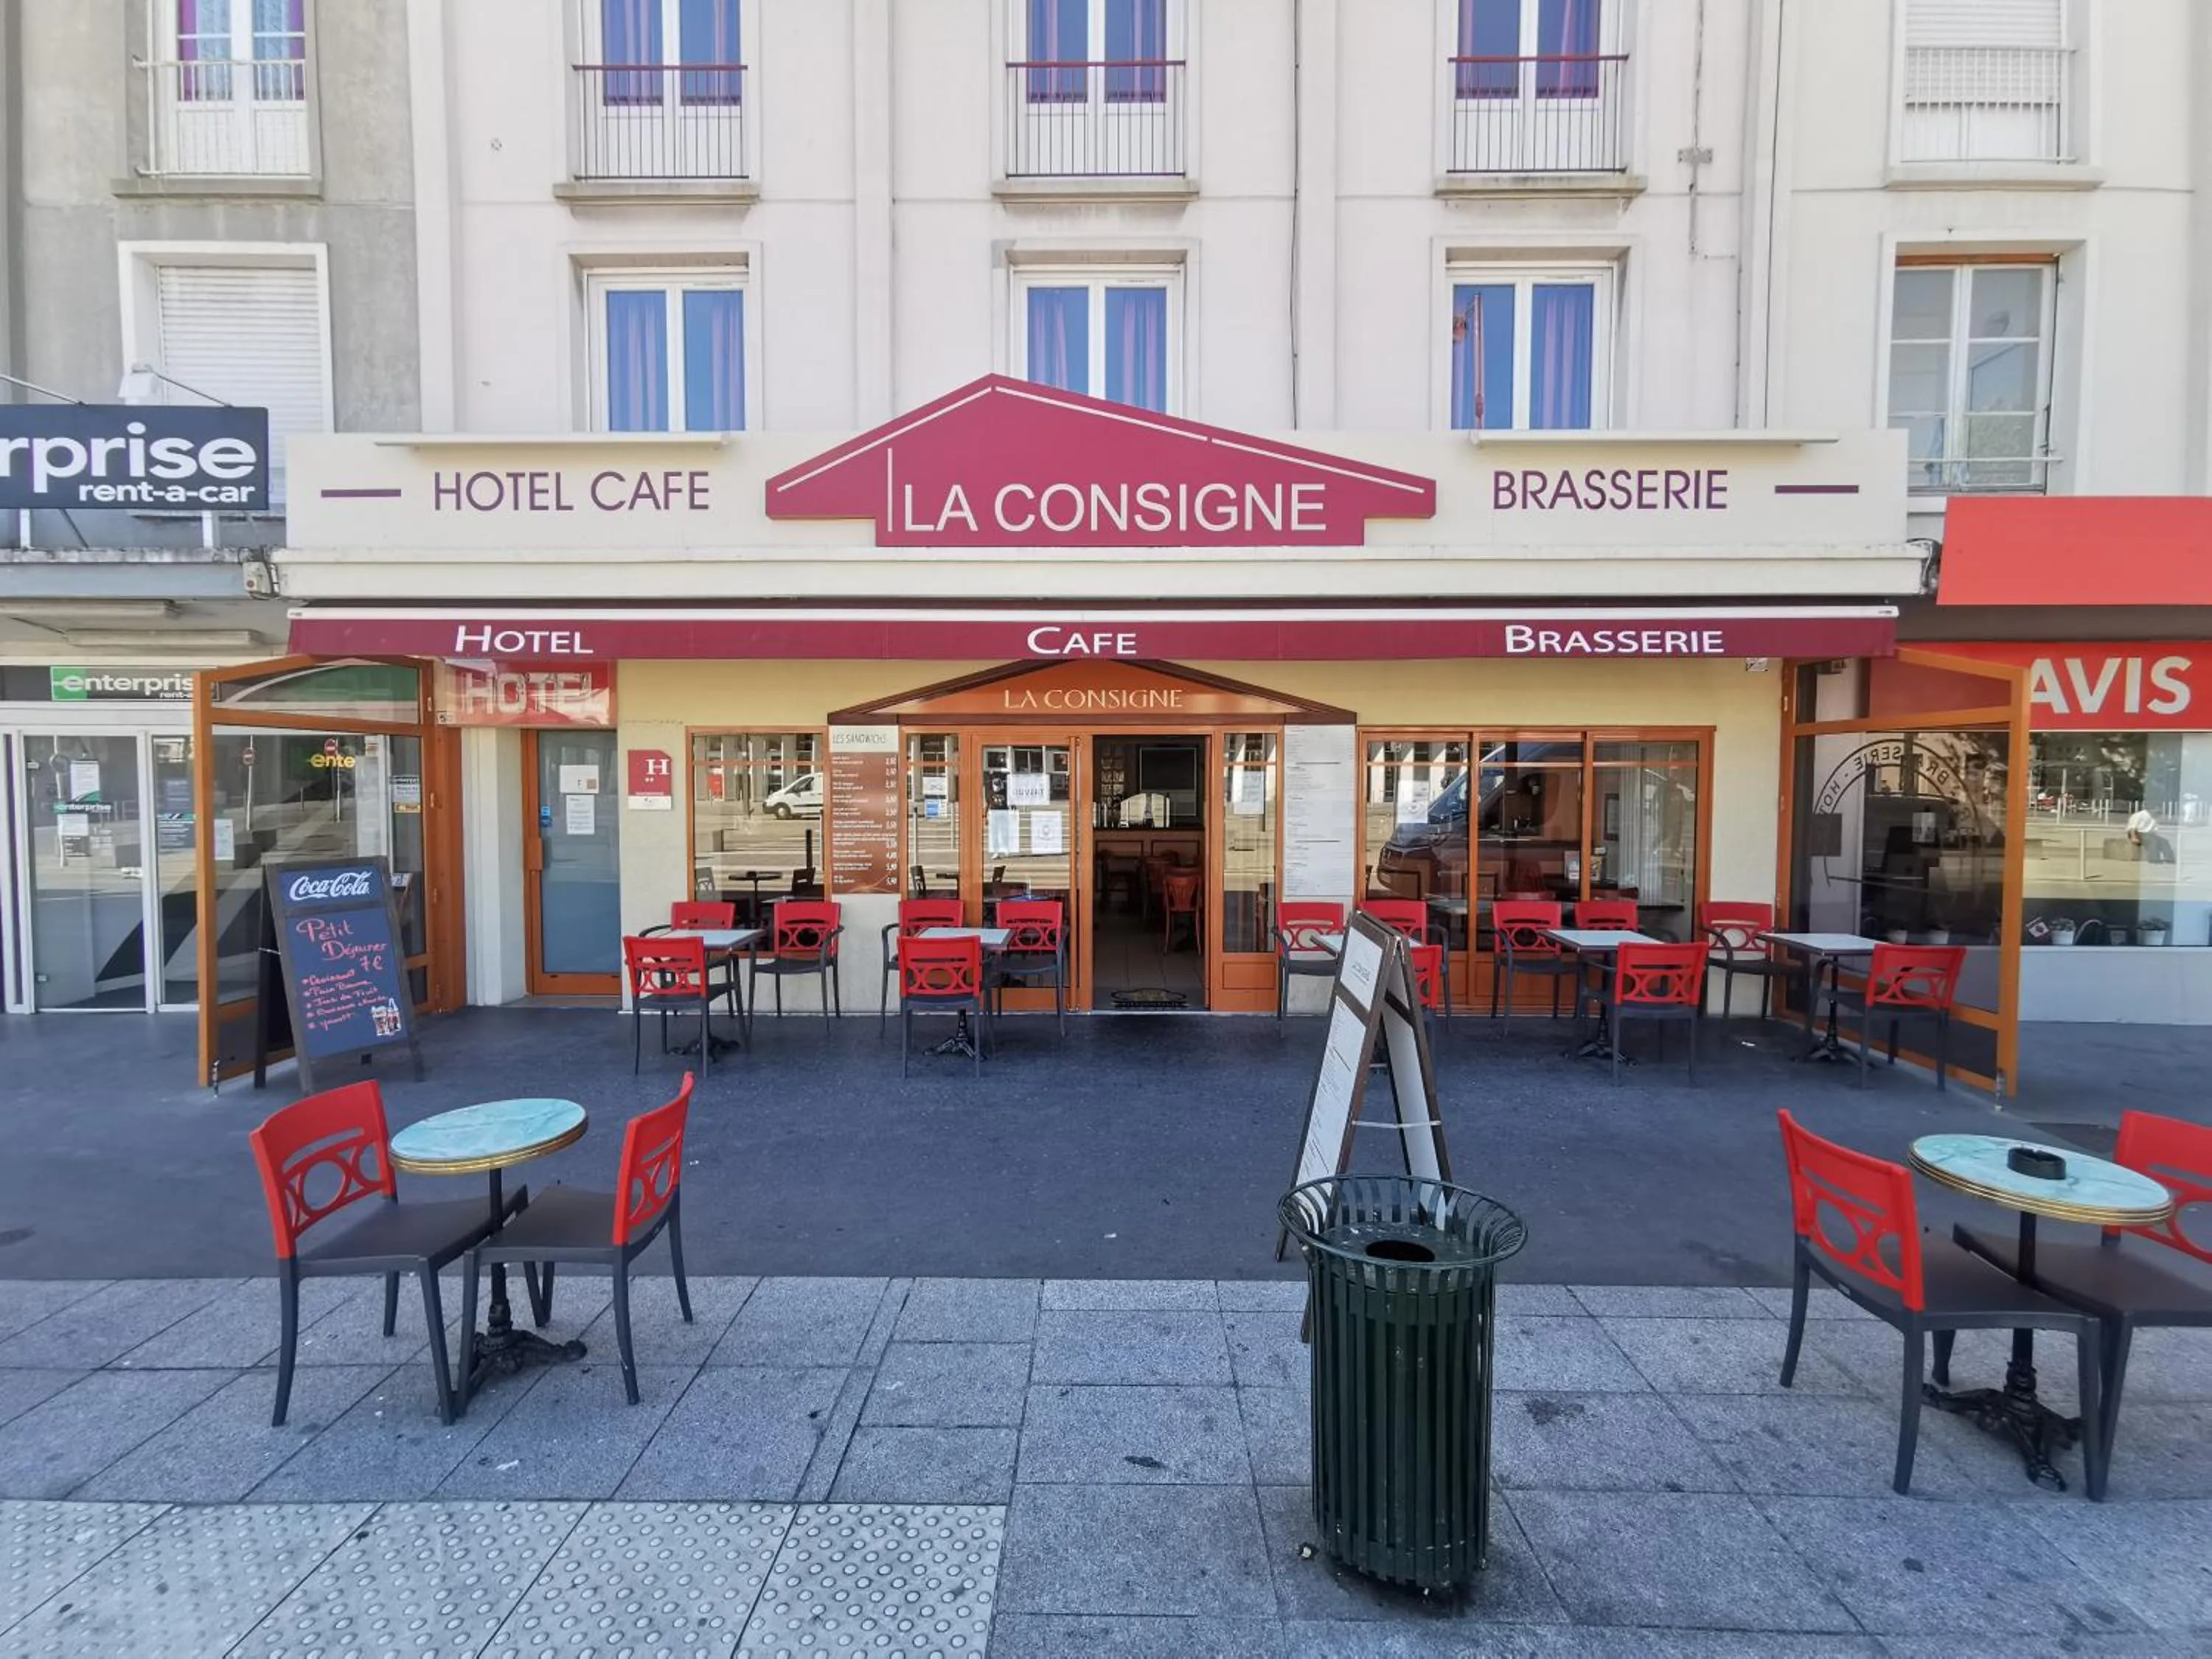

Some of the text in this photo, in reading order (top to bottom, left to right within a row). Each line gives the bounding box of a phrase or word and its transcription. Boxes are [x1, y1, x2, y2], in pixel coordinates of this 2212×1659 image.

[79, 481, 256, 504] rent-a-car
[434, 470, 709, 511] HOTEL CAFE
[1493, 470, 1728, 509] BRASSERIE
[904, 483, 1326, 532] LA CONSIGNE
[455, 625, 593, 654] HOTEL
[1027, 626, 1136, 654] CAFE
[1505, 625, 1725, 653] BRASSERIE
[60, 674, 194, 695] enterpris
[465, 672, 609, 715] HOTEL
[1004, 689, 1183, 709] LA CONSIGNE
[2029, 655, 2193, 714] AVIS
[645, 759, 670, 775] H
[289, 871, 372, 901] Coca-Cola
